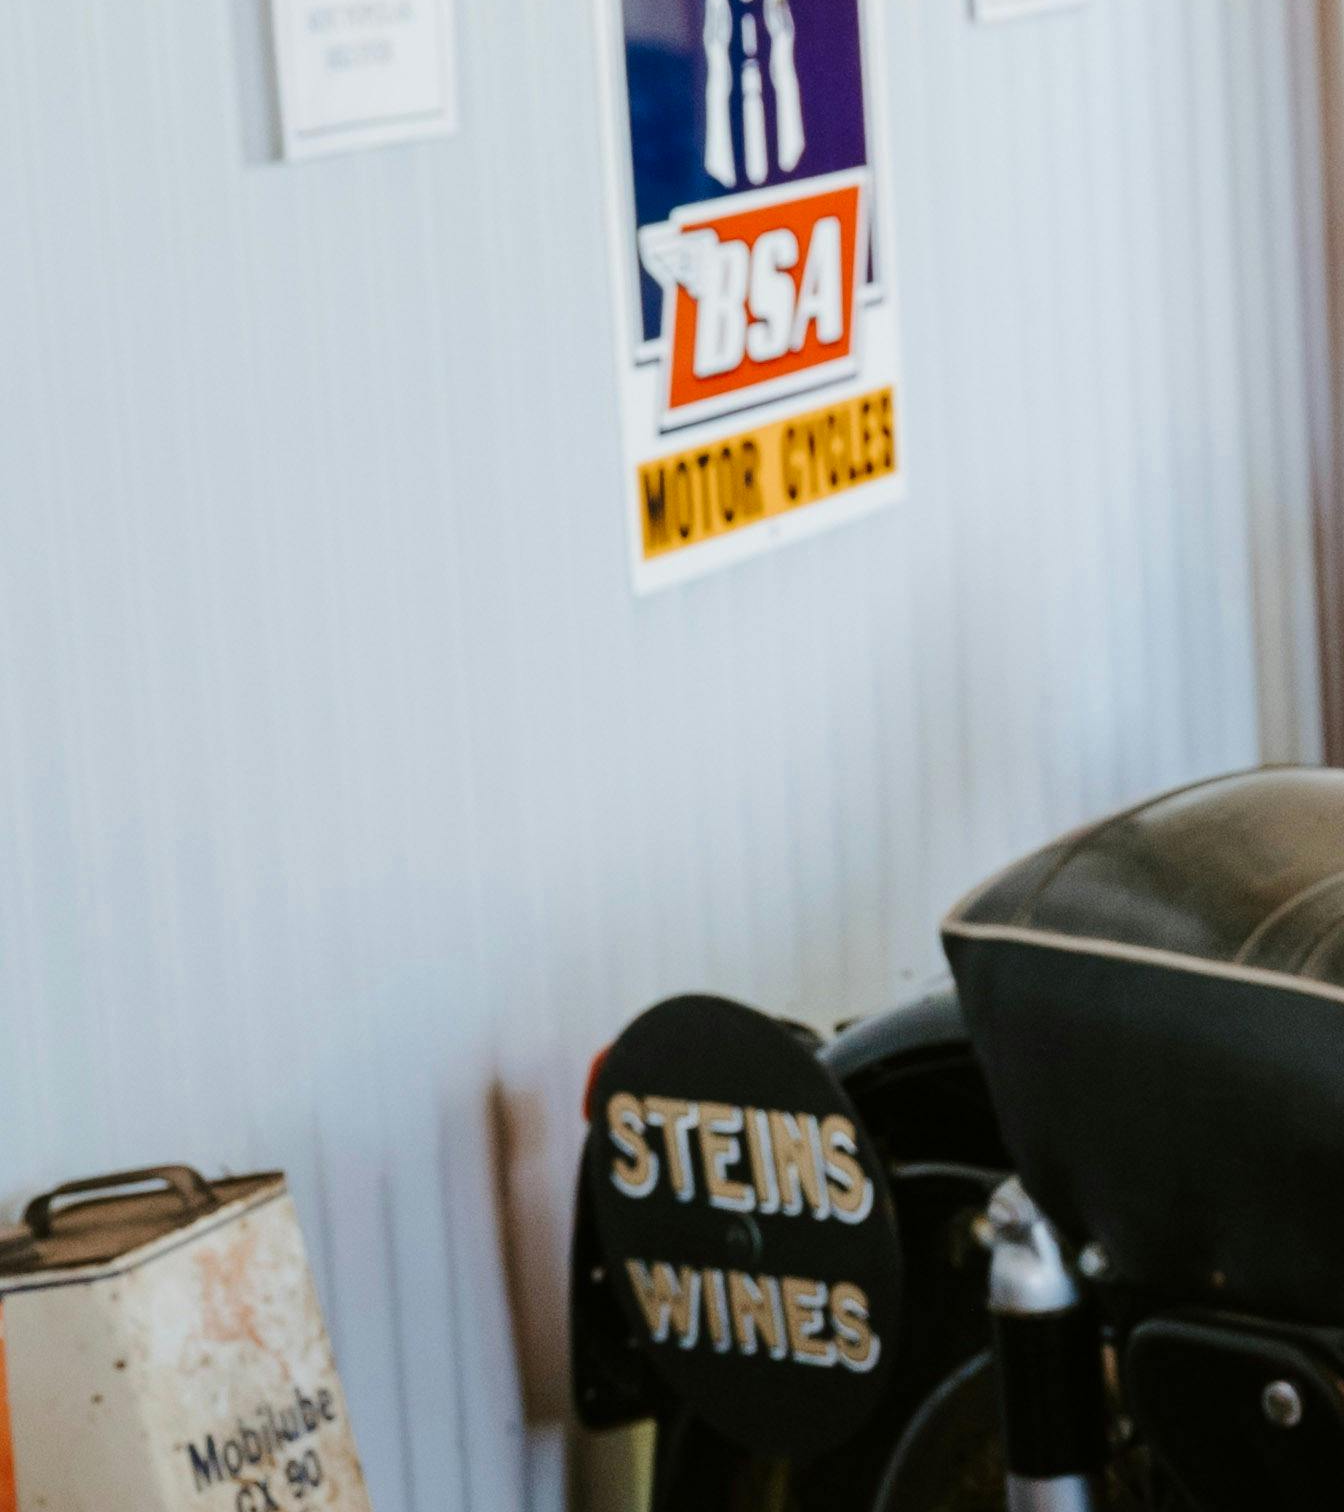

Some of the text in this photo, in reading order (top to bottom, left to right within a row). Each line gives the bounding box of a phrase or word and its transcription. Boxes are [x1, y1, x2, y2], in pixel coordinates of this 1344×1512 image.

[665, 213, 846, 379] BSA
[639, 384, 898, 550] MOTOR CYCLES
[607, 1092, 875, 1226] STEINS
[625, 1256, 882, 1374] WINES
